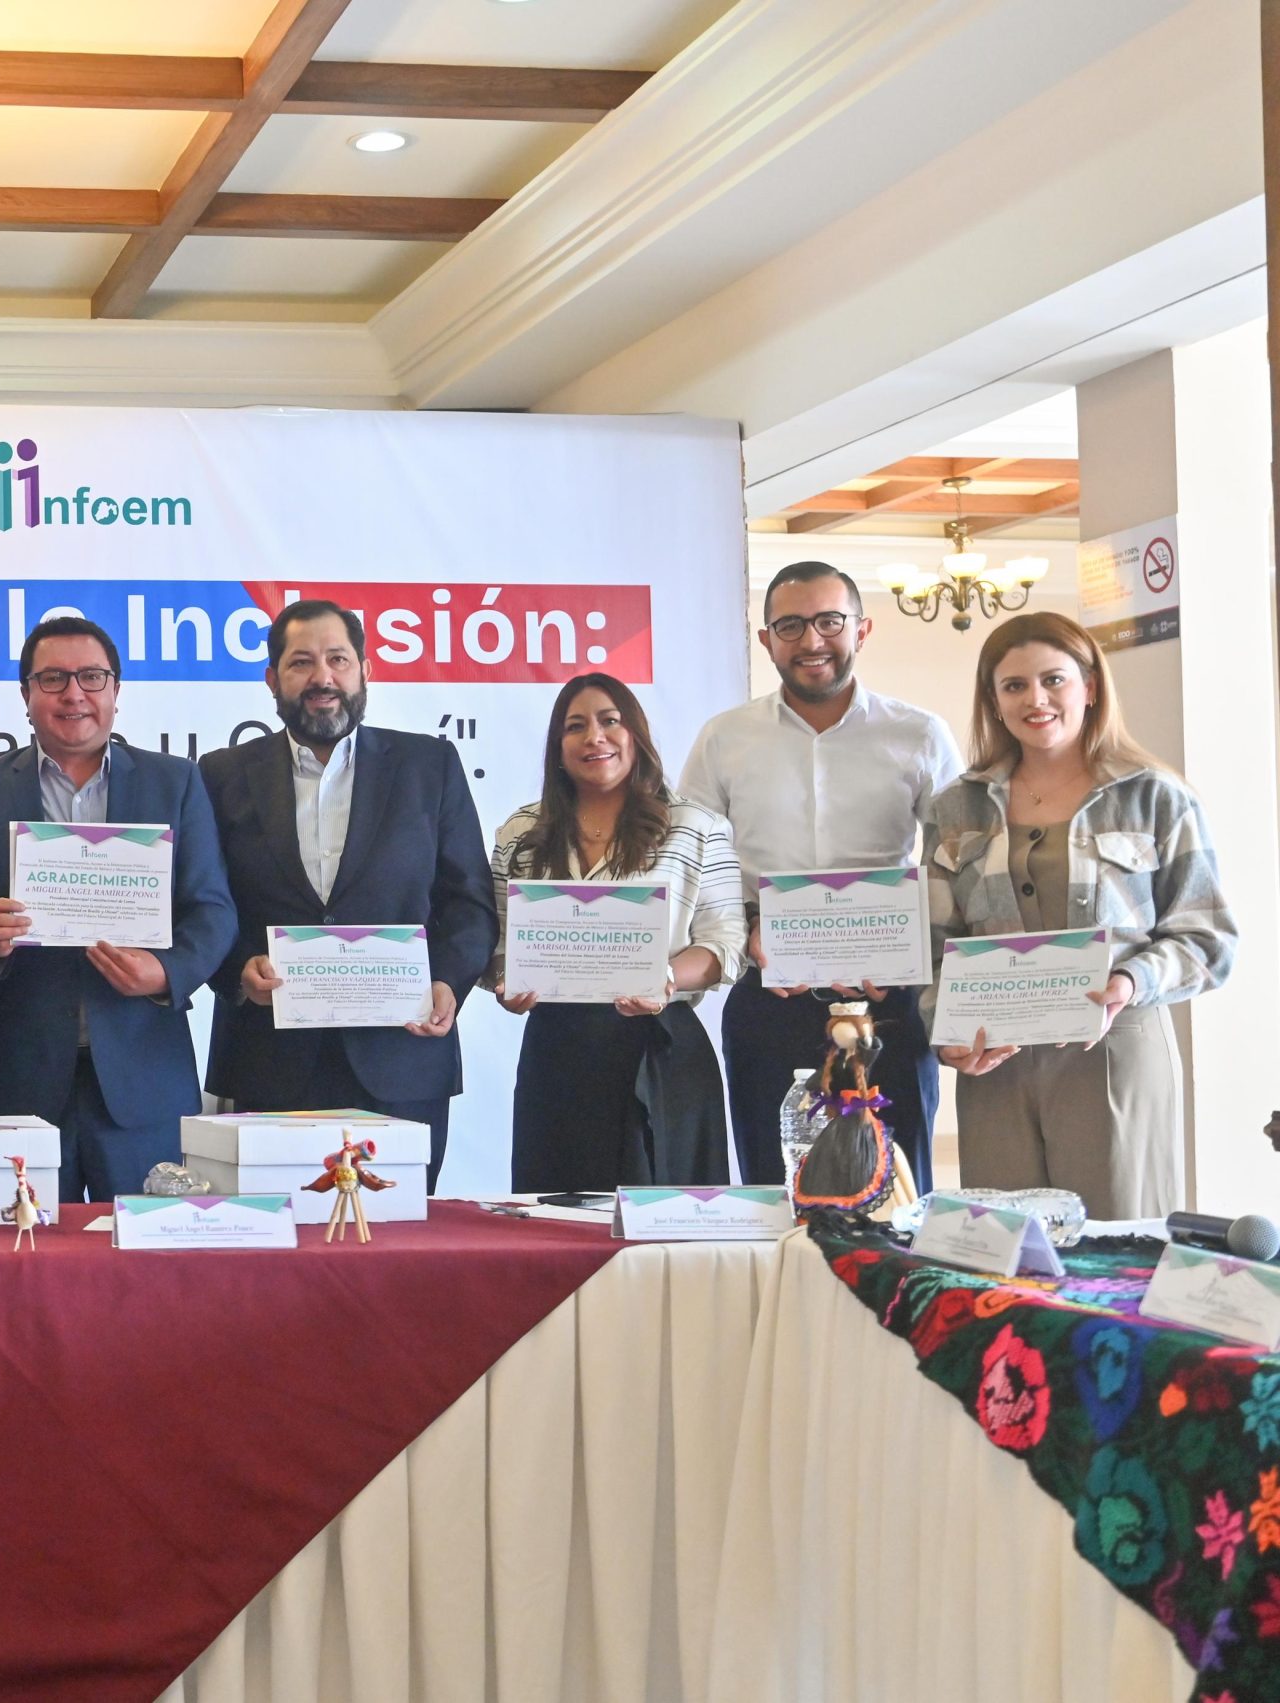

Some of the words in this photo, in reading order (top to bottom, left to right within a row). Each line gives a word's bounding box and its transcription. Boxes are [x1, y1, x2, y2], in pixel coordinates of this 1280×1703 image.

[8, 588, 87, 662] l
[127, 588, 607, 666] Incsión:
[26, 871, 160, 889] AGRADECIMIENTO
[31, 885, 63, 894] MIGUEL
[132, 890, 161, 899] PONCE
[771, 914, 909, 931] RECONOCIMIENTO
[517, 929, 654, 944] RECONOCIMIENTO
[782, 931, 809, 940] JORGE
[810, 930, 833, 939] JUAN
[834, 929, 859, 937] VILLA
[532, 943, 572, 951] MARISOL
[287, 965, 420, 976] RECONOCIMIENTO
[950, 975, 1091, 993] RECONOCIMIENTO
